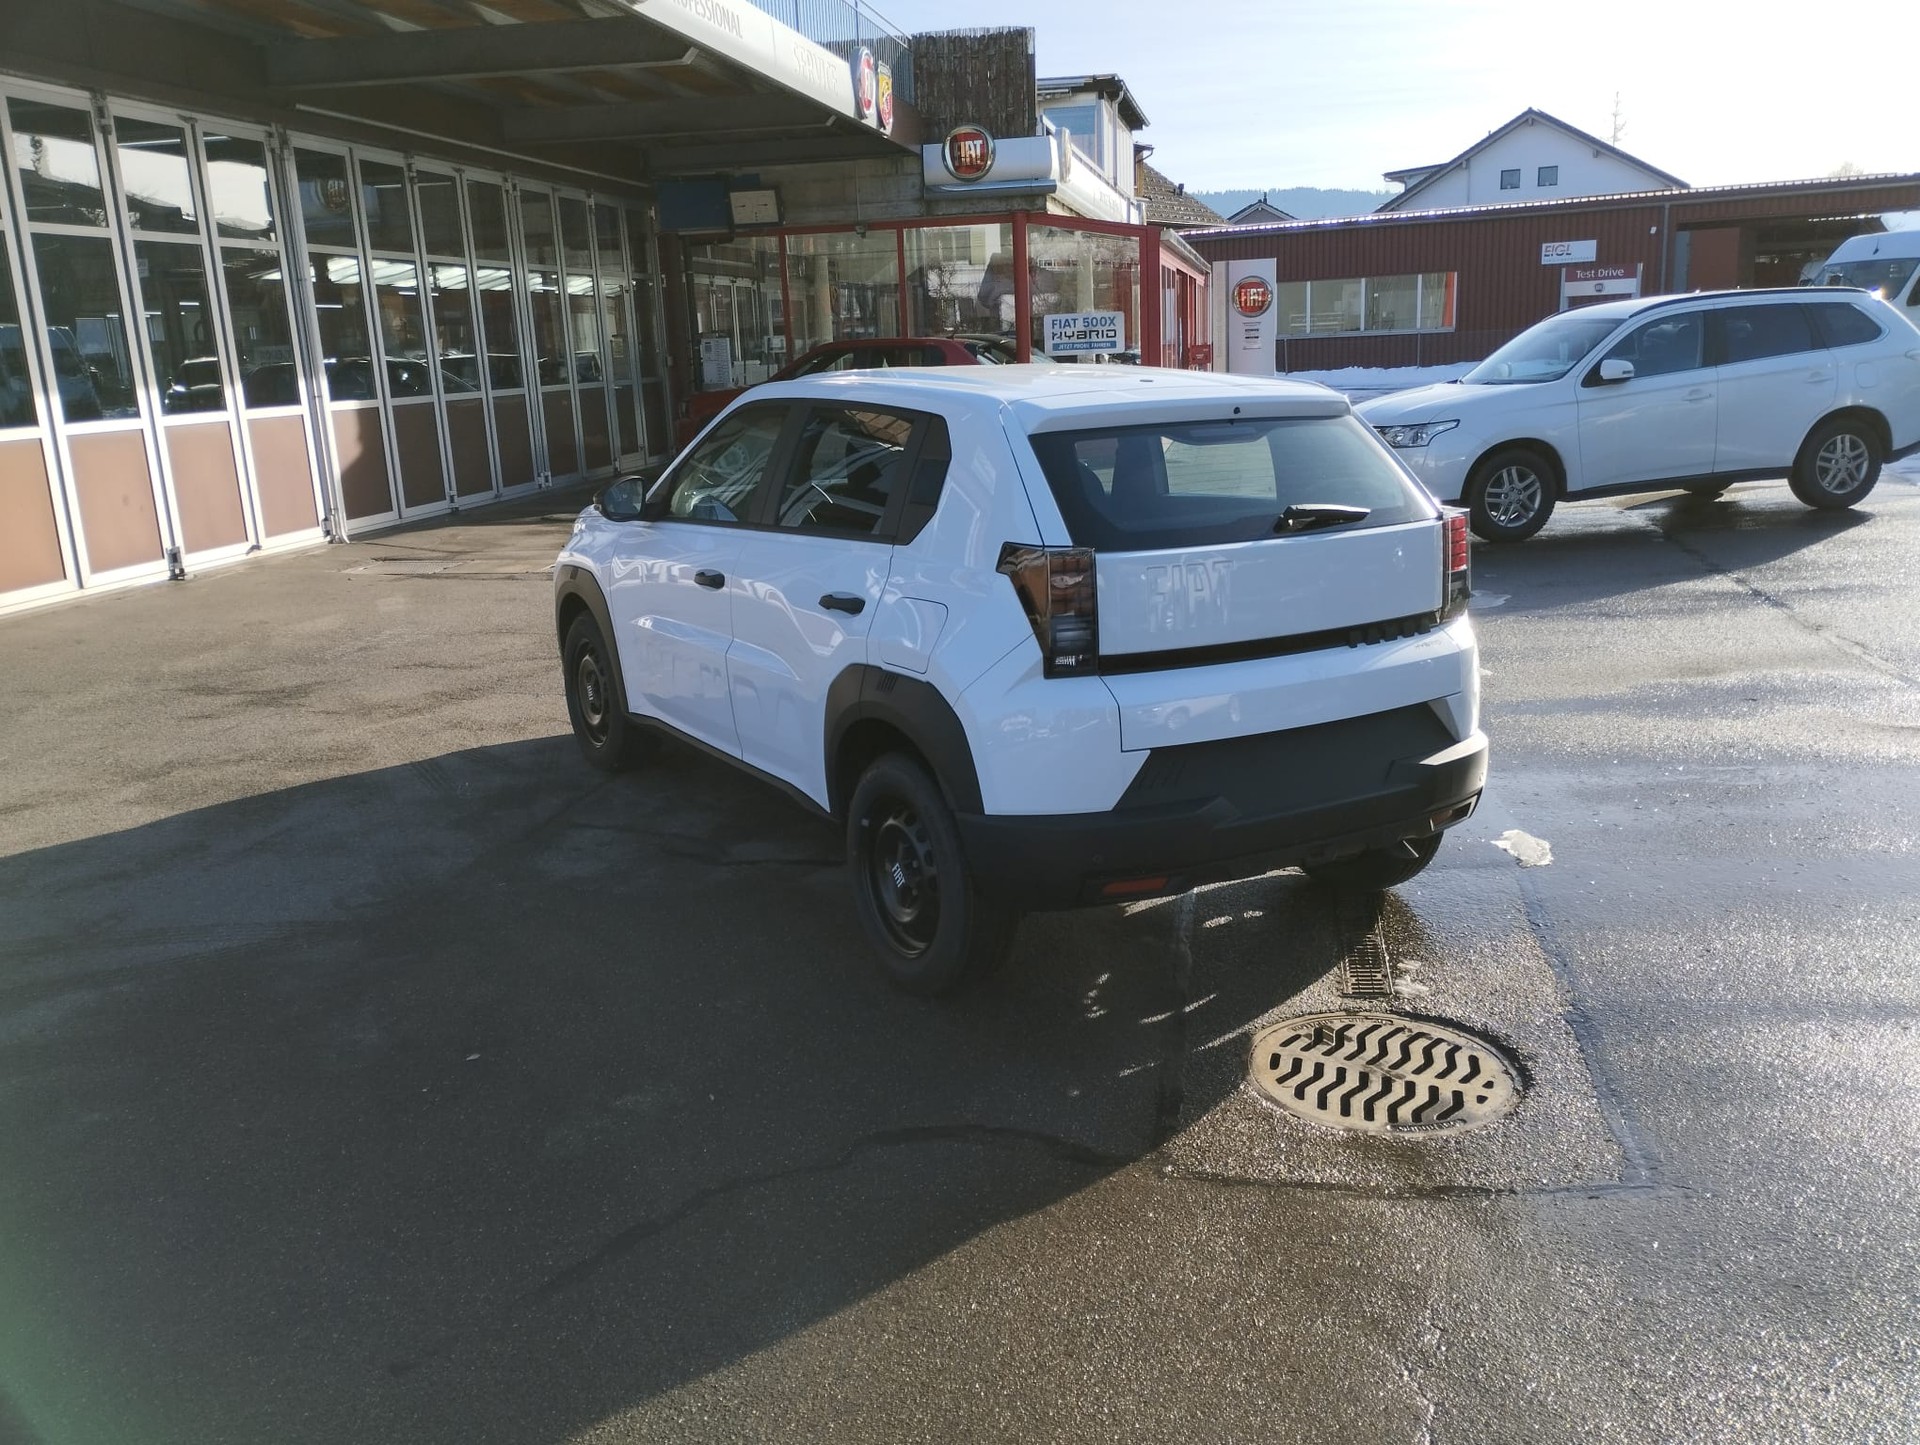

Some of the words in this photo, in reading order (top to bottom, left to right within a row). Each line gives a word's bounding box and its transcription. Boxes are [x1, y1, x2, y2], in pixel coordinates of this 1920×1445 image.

[953, 139, 984, 166] FIAT
[1543, 244, 1572, 257] EIGL
[1576, 270, 1595, 279] Test
[1598, 267, 1625, 278] Drive
[1240, 288, 1265, 307] FIAT
[1052, 318, 1078, 330] FIAT
[1082, 316, 1117, 328] 500X
[1052, 329, 1117, 341] HYBRID
[1146, 559, 1235, 632] FIAT
[891, 862, 906, 888] FIAT
